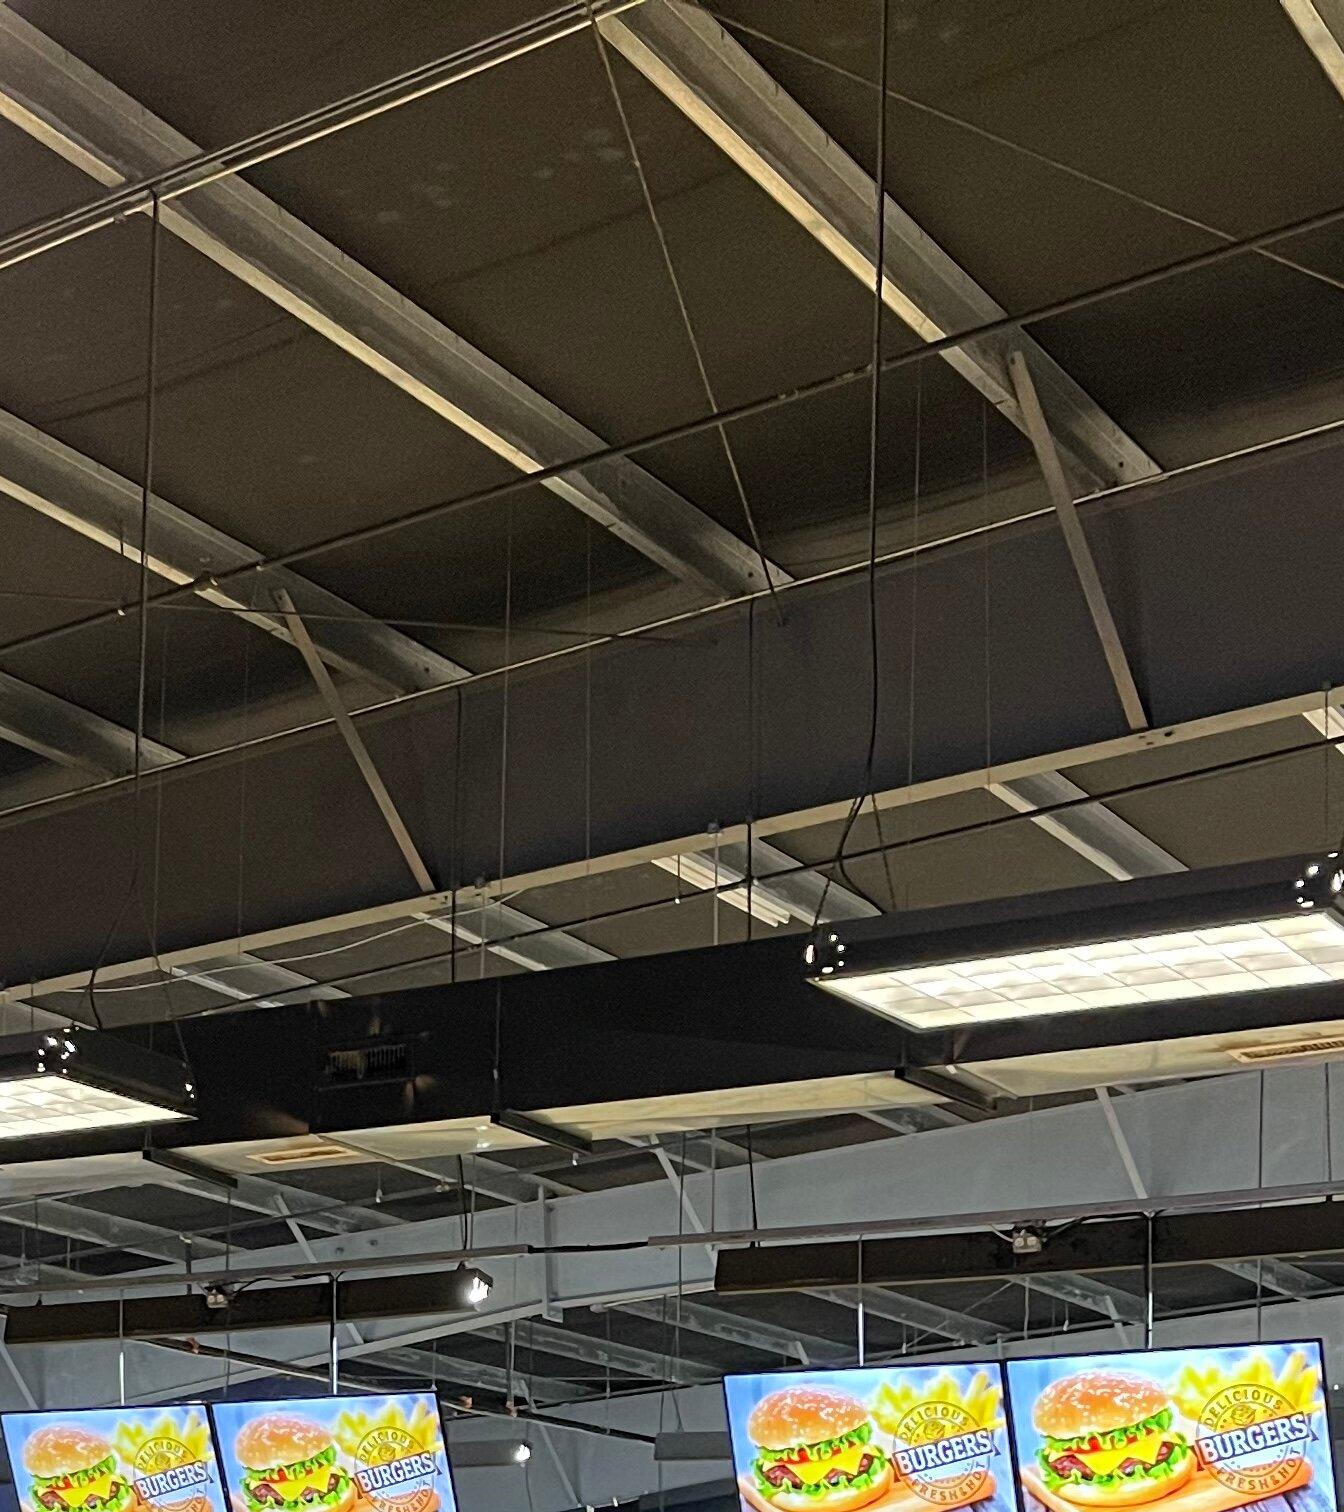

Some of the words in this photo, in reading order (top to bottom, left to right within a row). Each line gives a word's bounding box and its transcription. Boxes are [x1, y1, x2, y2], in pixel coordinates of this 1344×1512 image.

[899, 1407, 969, 1441] DELICIOUS
[1203, 1389, 1283, 1428] DELICIOUS
[896, 1430, 992, 1474] BURGERS
[1198, 1413, 1309, 1464] BURGERS
[136, 1461, 207, 1499] BURGERS
[357, 1452, 435, 1492] BURGERS
